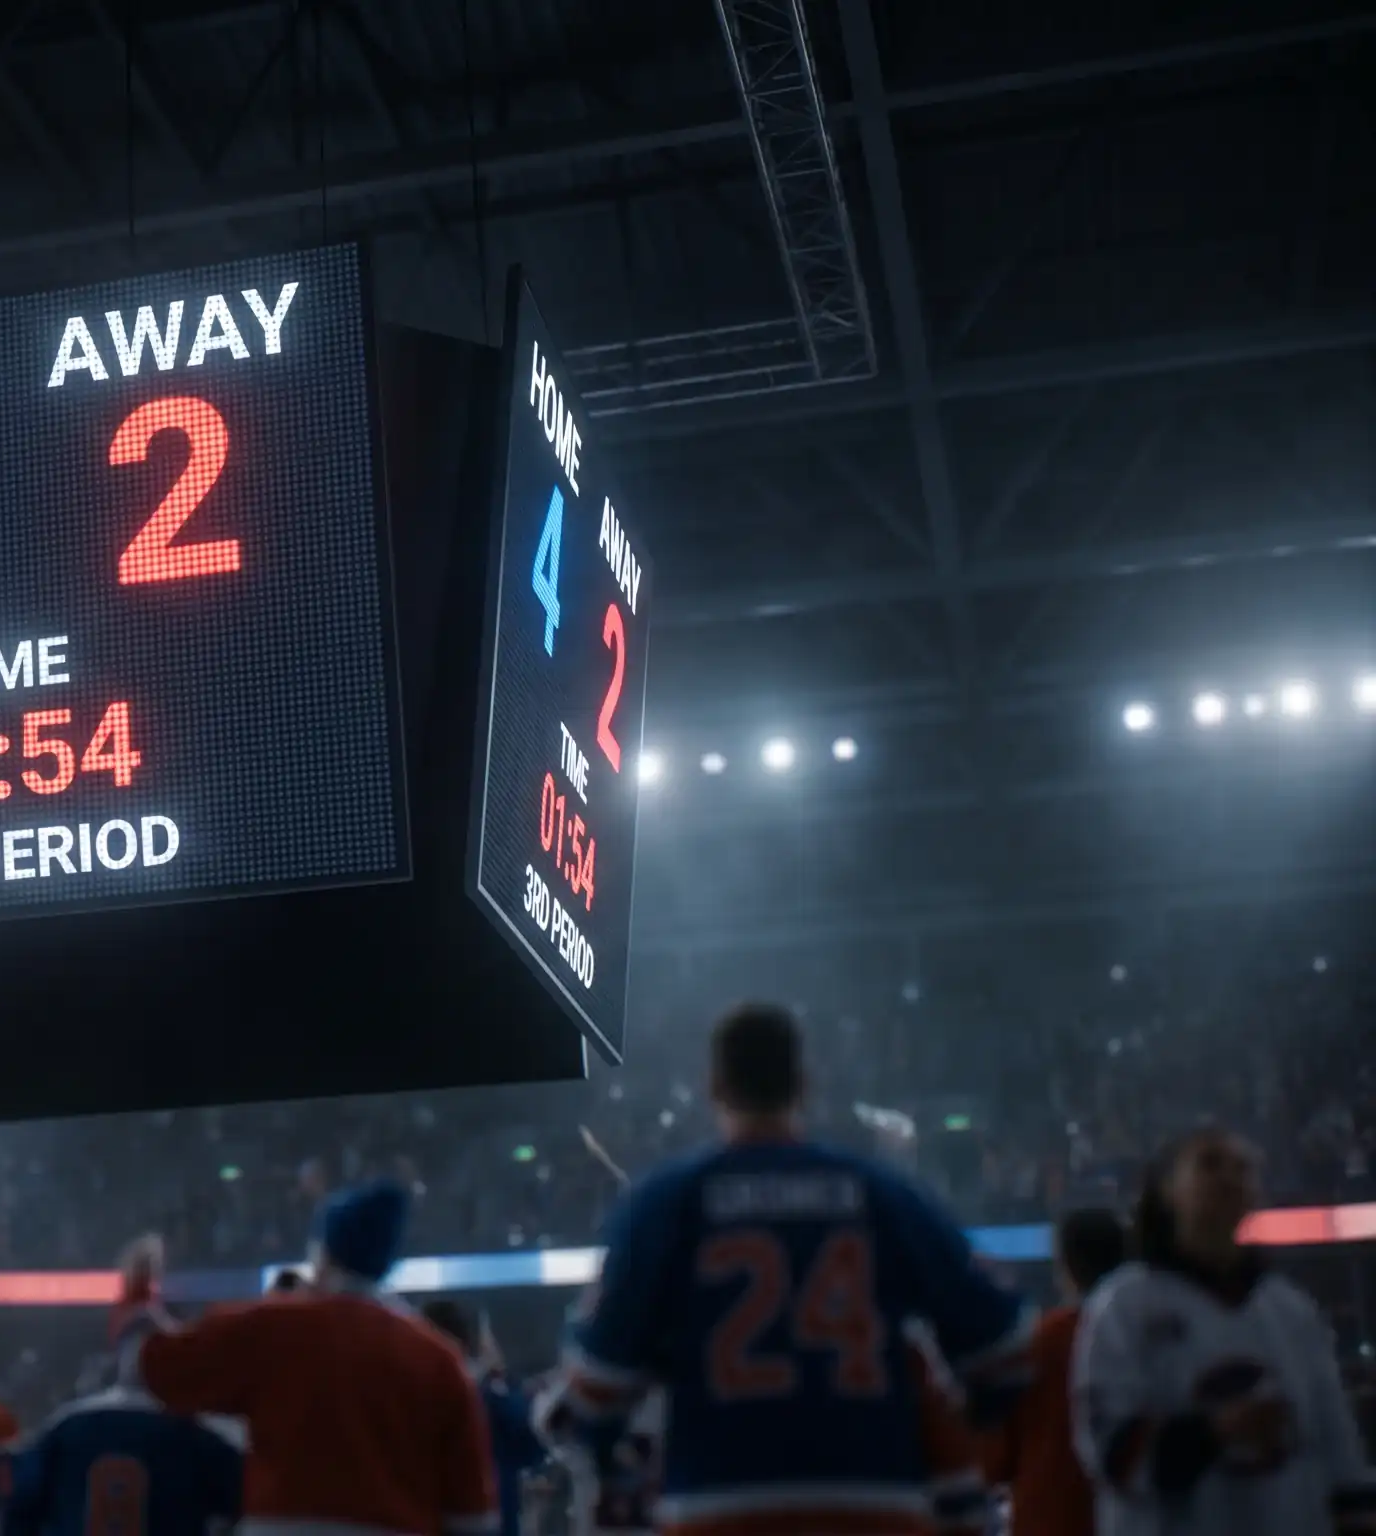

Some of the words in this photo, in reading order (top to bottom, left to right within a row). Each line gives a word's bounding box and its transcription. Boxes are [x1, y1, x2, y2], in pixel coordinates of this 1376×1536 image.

[48, 282, 299, 387] AWAY
[108, 397, 241, 585] 2
[530, 340, 582, 498] HOME
[531, 484, 564, 658] 4
[599, 496, 642, 616] AWAY
[597, 604, 625, 773] 2
[560, 722, 589, 804] TIME
[540, 773, 596, 912] 01:54
[524, 864, 550, 932] 3RD
[551, 898, 594, 989] PERIOD
[693, 1226, 891, 1402] 24
